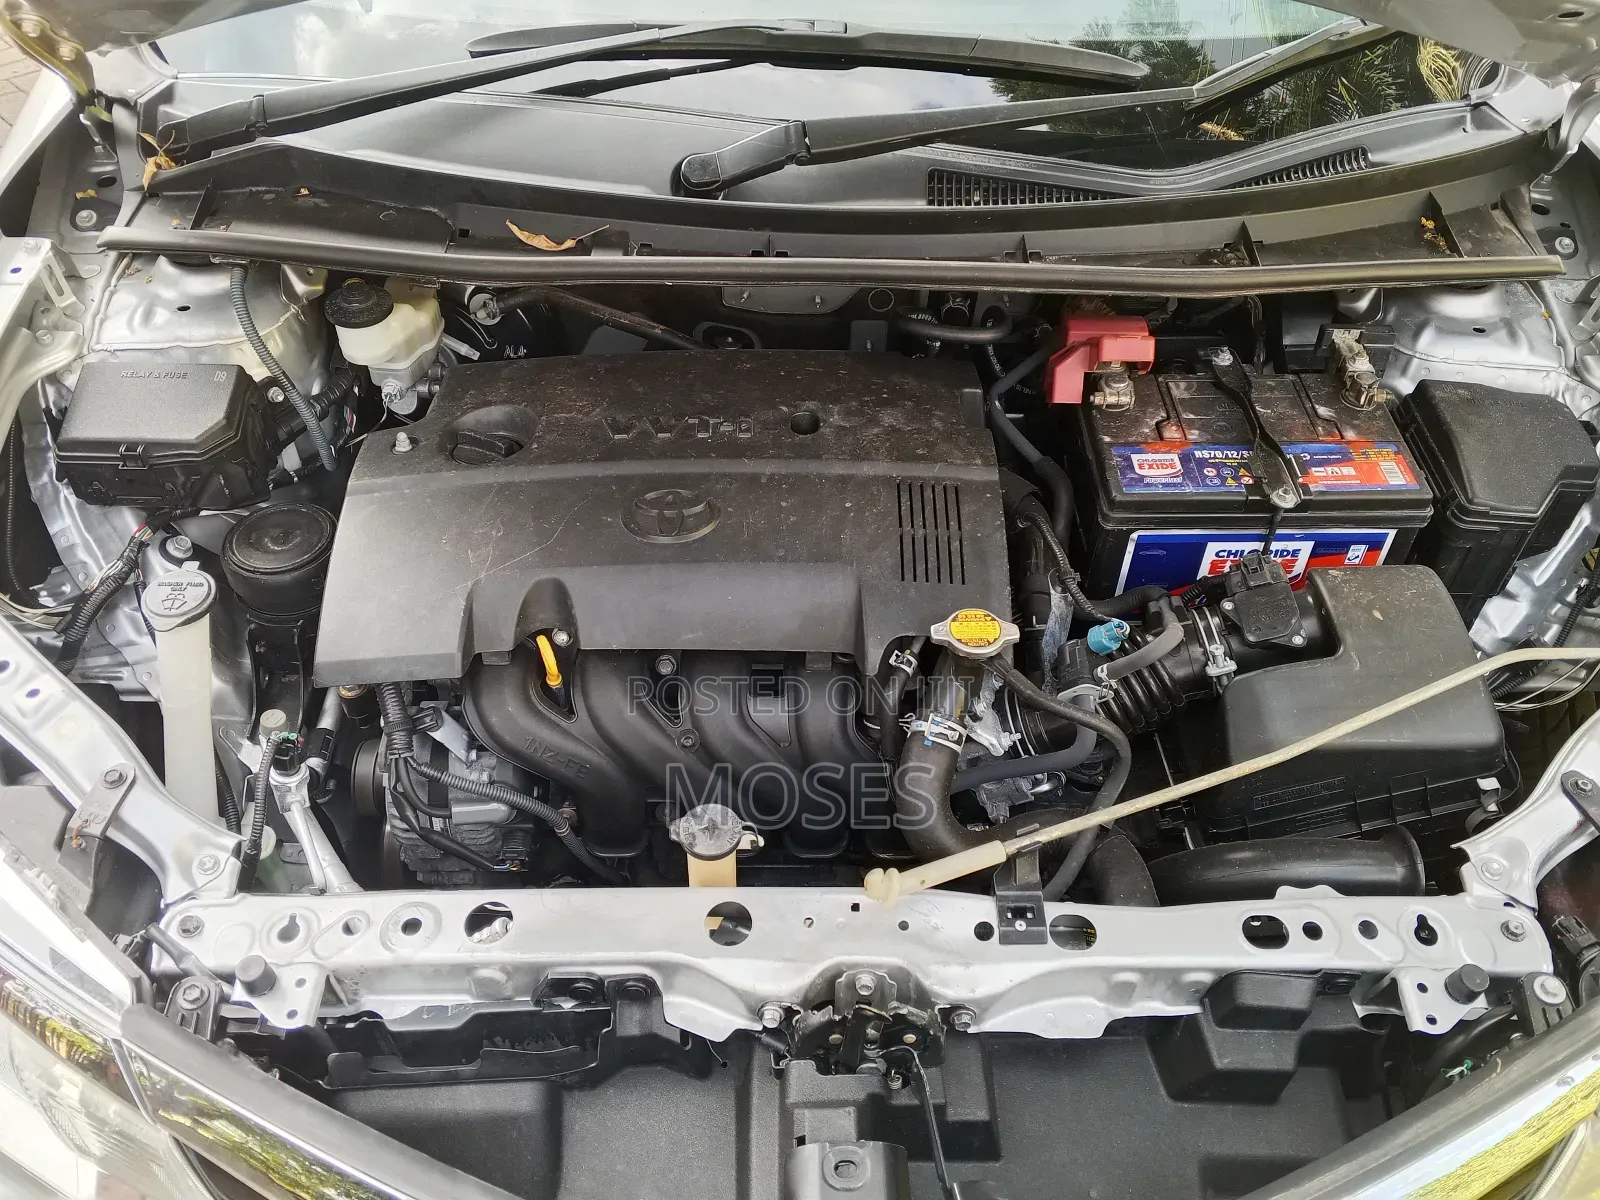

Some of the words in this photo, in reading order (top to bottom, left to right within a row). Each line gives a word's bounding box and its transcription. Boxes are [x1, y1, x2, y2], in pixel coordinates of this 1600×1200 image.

[154, 371, 161, 379] &
[1137, 462, 1178, 470] EXIDE
[523, 736, 590, 779] 1NZ-FE
